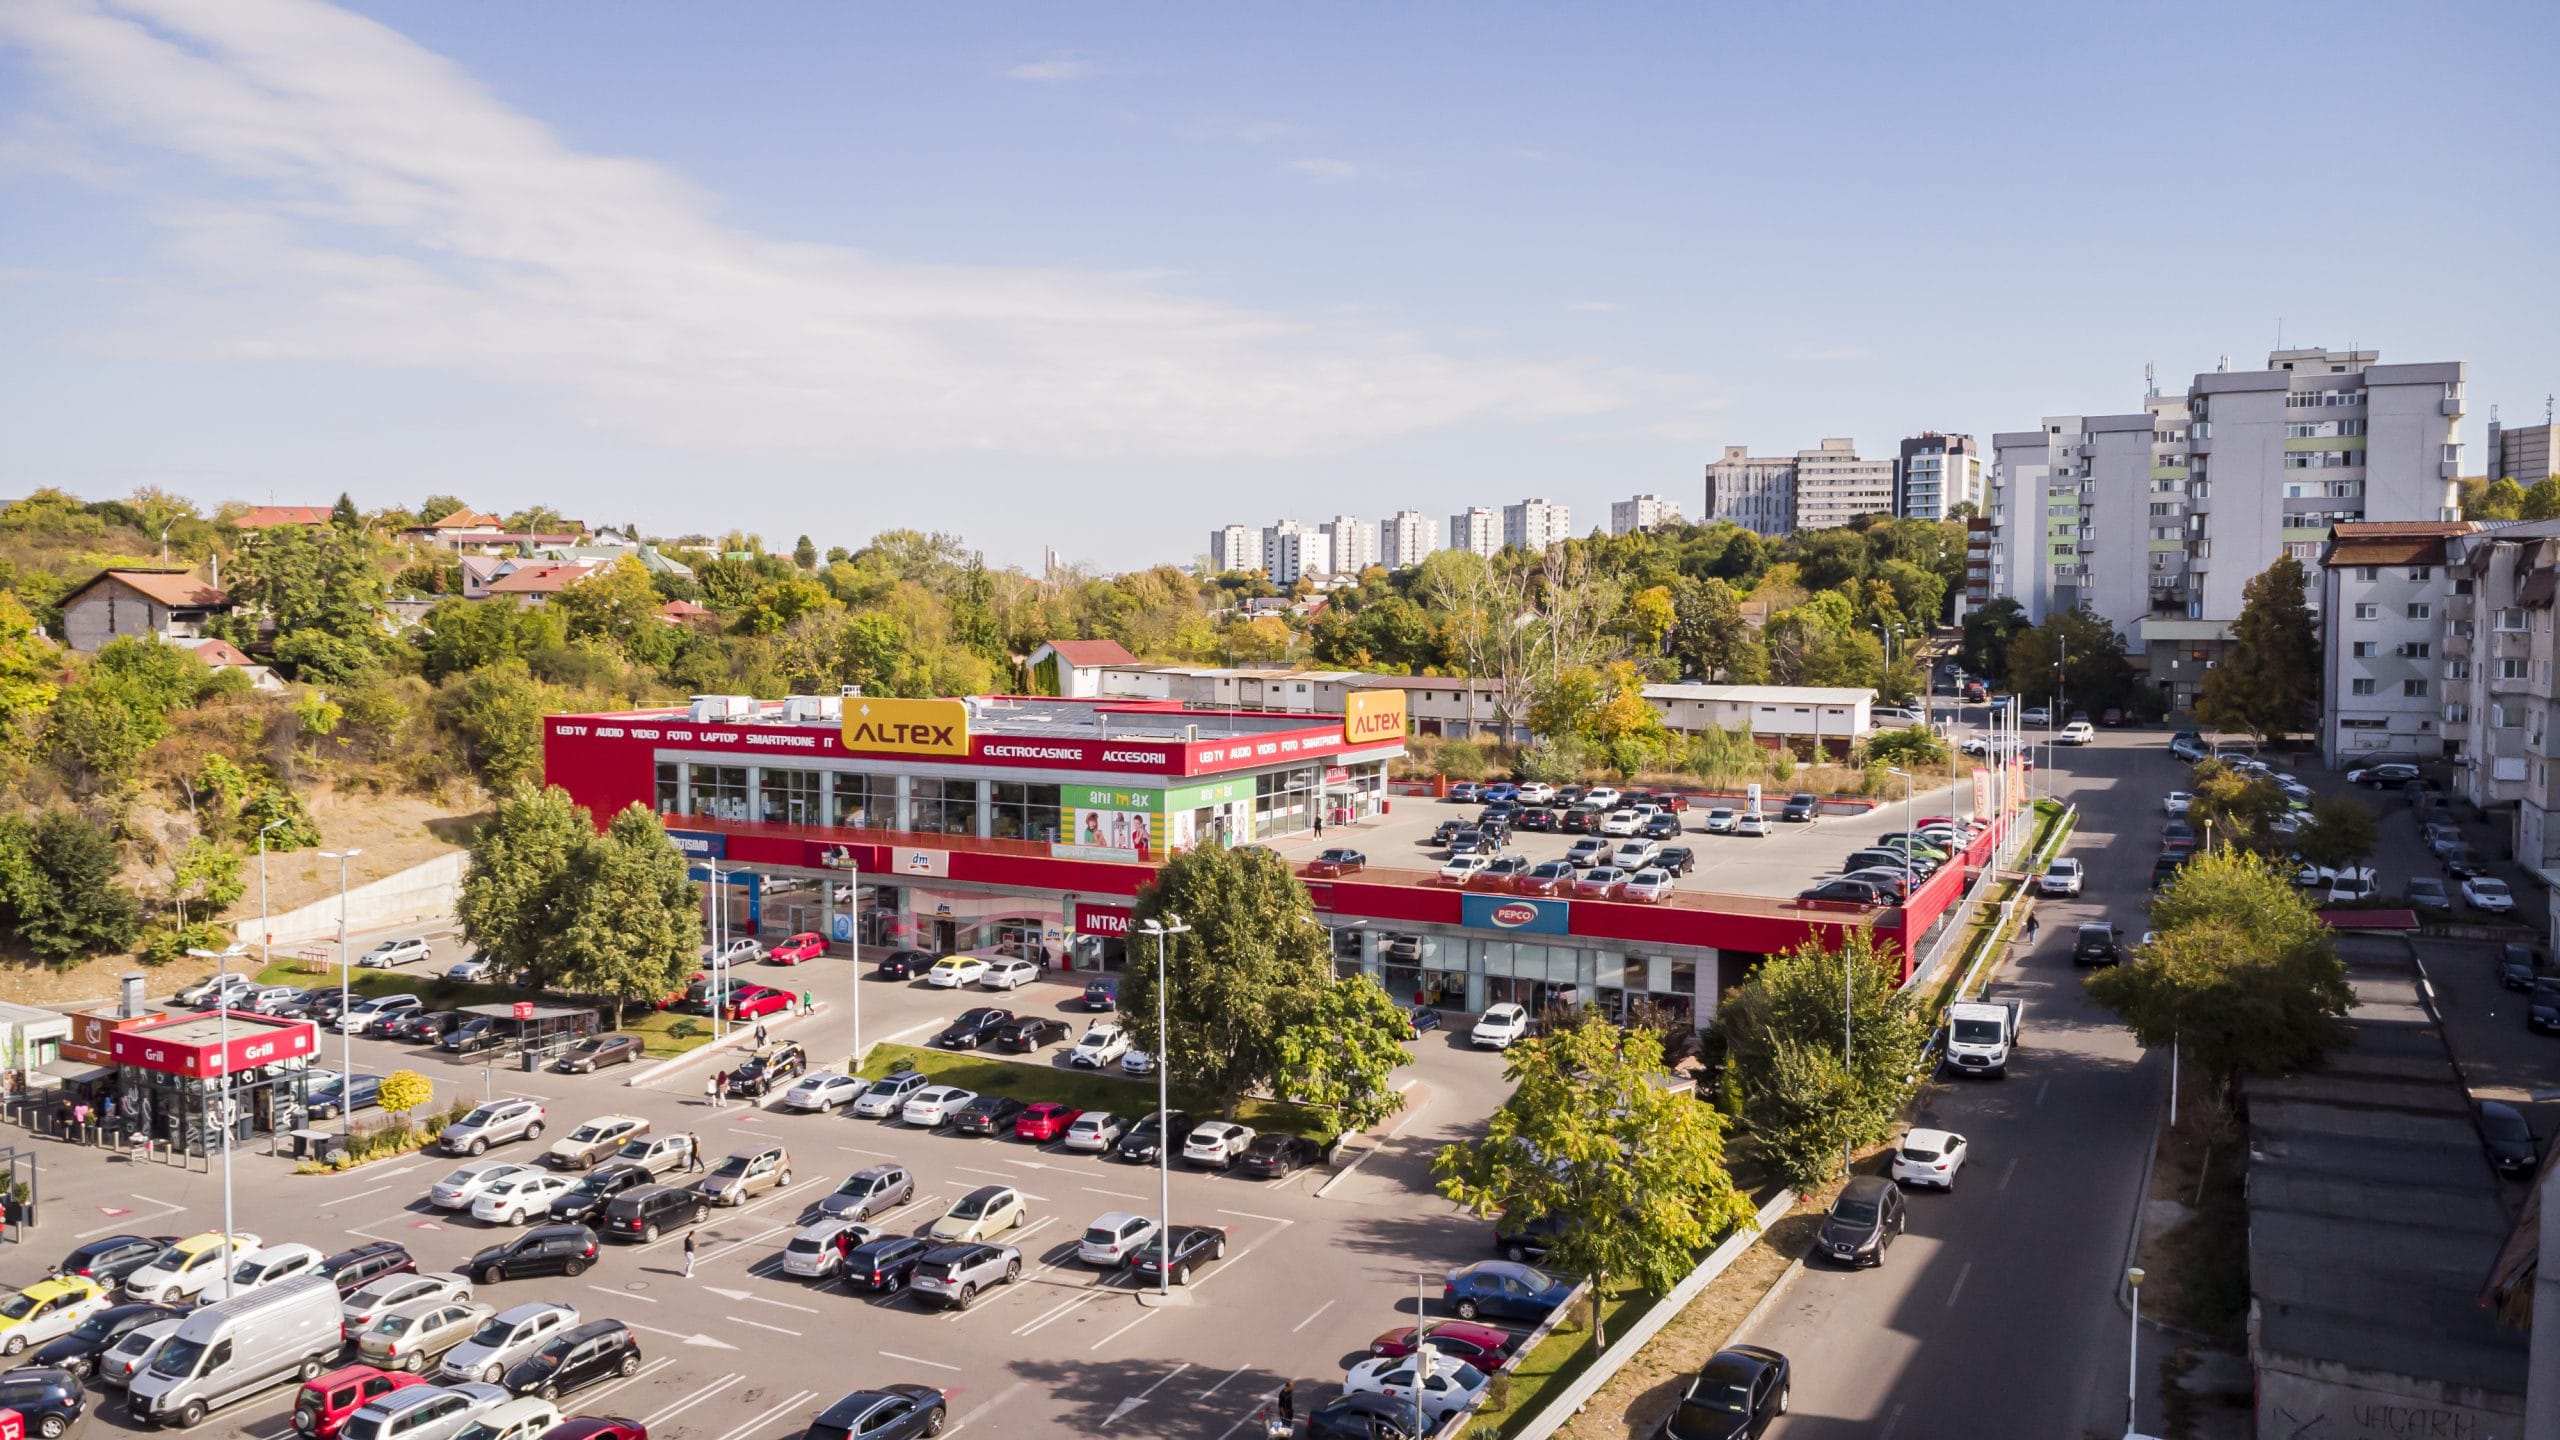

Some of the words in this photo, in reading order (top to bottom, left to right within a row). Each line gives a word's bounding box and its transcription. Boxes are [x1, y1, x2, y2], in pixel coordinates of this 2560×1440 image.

[1355, 712, 1400, 735] ALTEX
[556, 725, 573, 735] LED
[574, 726, 587, 736] TV
[595, 727, 624, 738] AUDIO
[631, 728, 659, 740] VIDEO
[667, 731, 692, 741] FOTO
[700, 732, 738, 743] LAPTOP
[746, 734, 815, 747] SMARTPHONE
[823, 737, 834, 748] IT
[853, 722, 955, 746] ALTEX
[983, 745, 1082, 760] ELECTROCASNICE
[1102, 750, 1166, 764] ACCESORII
[1200, 751, 1213, 763] LED
[1214, 750, 1224, 761] TV
[1230, 747, 1251, 759] AUDIO
[1257, 743, 1276, 755] VIDEO
[1281, 740, 1298, 752] FOTO
[1302, 734, 1342, 749] SMARTPHONE
[912, 853, 928, 864] dm
[937, 903, 950, 912] dm
[1498, 909, 1531, 920] PEPCO
[1086, 913, 1134, 933] INTRA
[1047, 929, 1060, 937] dm
[145, 1048, 164, 1062] Grill
[245, 1041, 274, 1059] Grill
